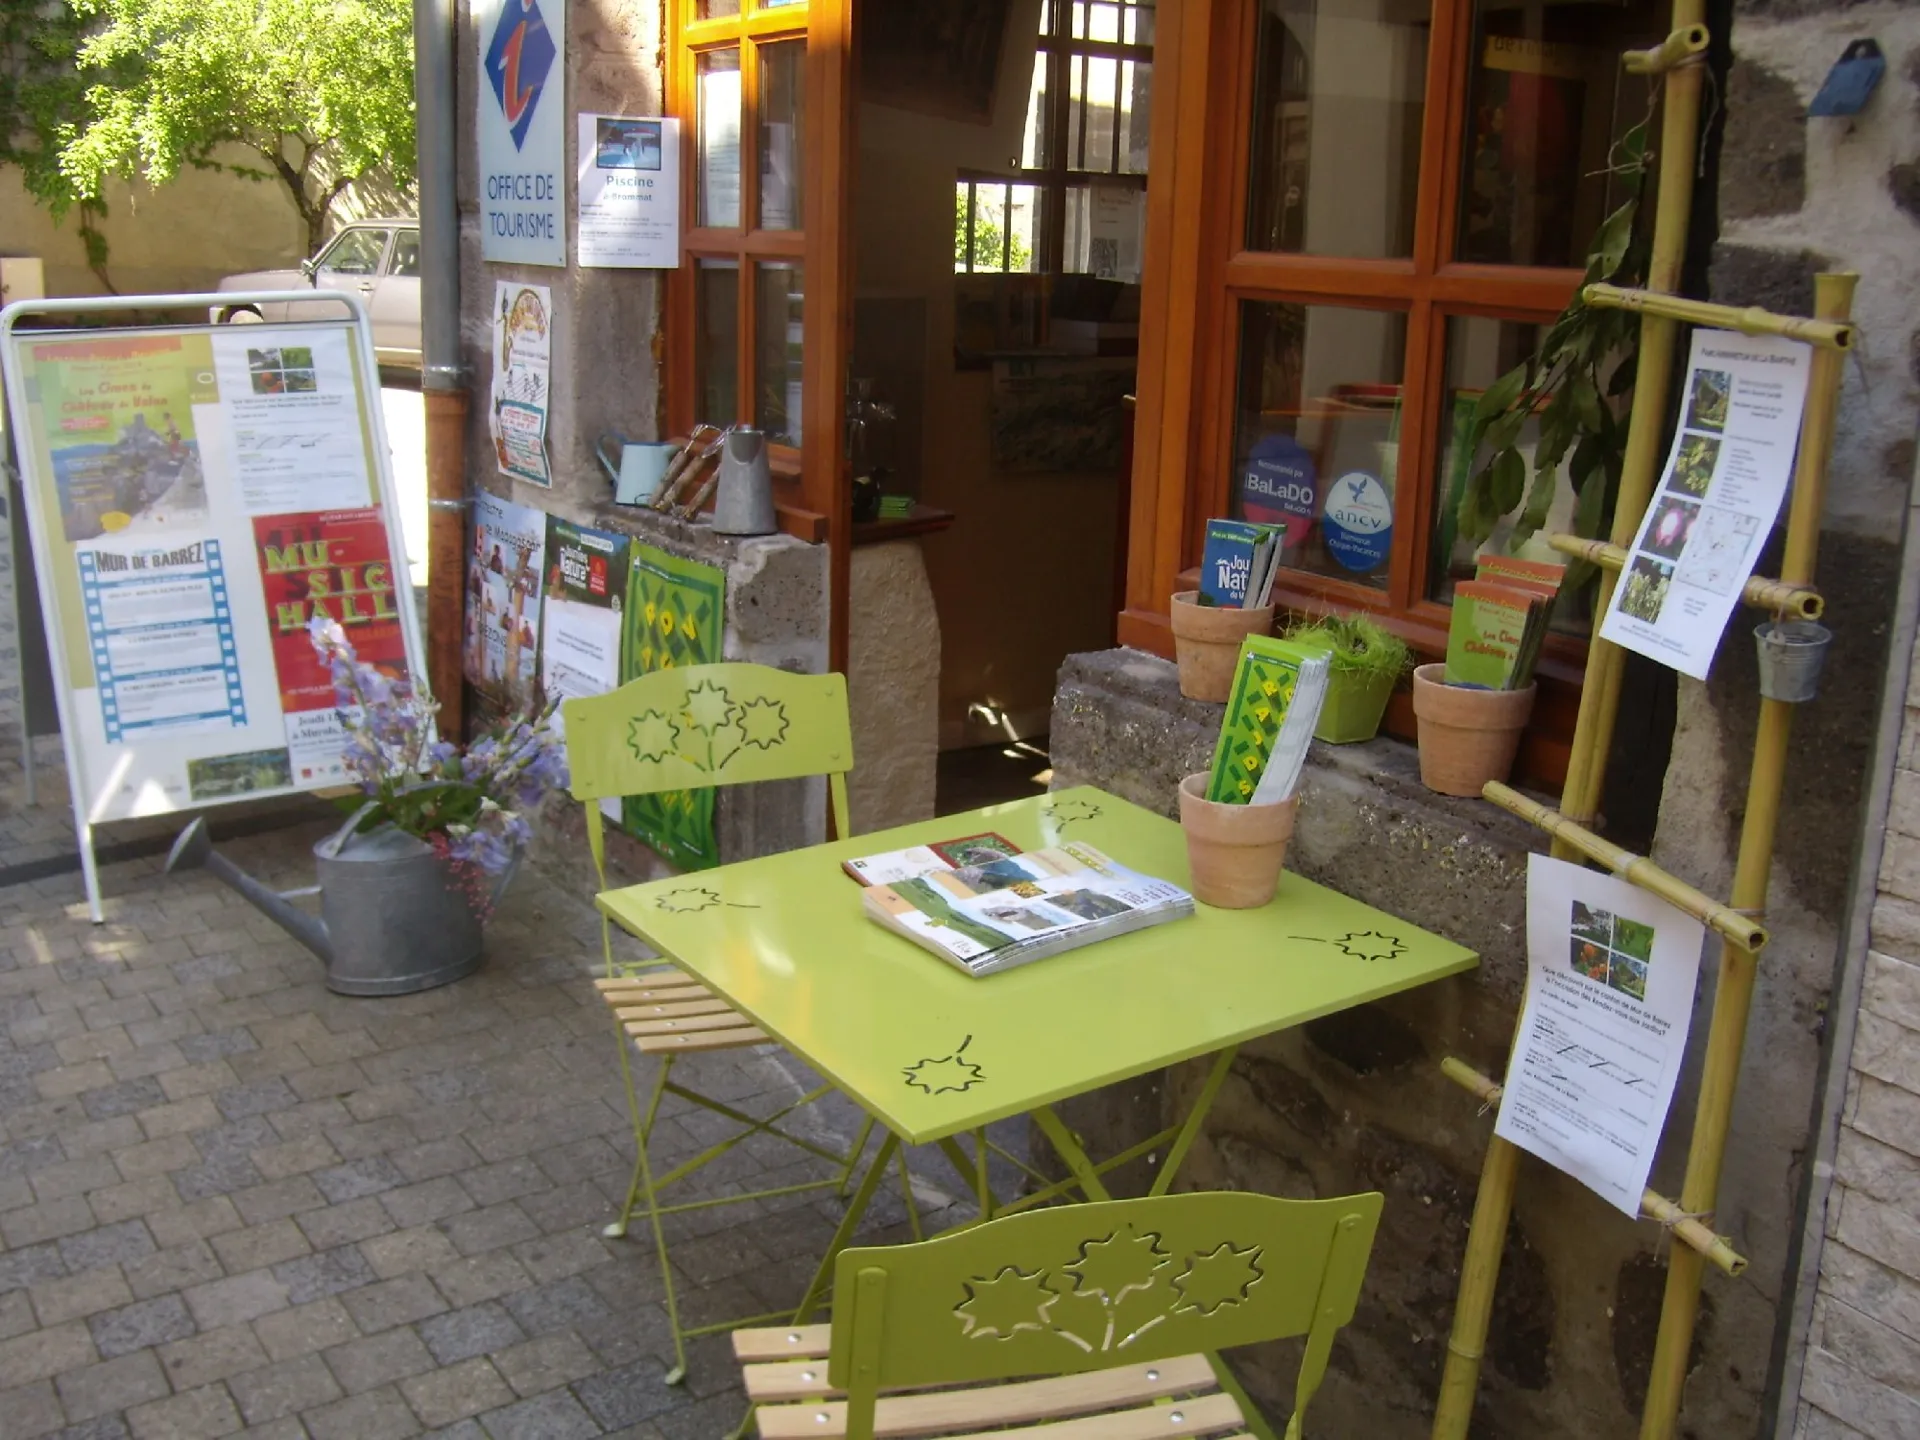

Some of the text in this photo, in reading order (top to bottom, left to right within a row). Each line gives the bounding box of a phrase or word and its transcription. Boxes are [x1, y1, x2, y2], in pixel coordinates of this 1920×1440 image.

[488, 174, 554, 201] OFFICE DE
[606, 175, 654, 188] Piscine
[612, 193, 652, 202] Brommat
[488, 212, 554, 239] TOURISME
[1248, 473, 1314, 505] BaLaDO
[1334, 509, 1382, 529] ancv
[95, 541, 204, 573] MUR DE BARREZ
[264, 540, 328, 574] MU
[1230, 554, 1250, 570] Jou
[307, 564, 388, 598] SIC
[1218, 565, 1247, 590] Nat
[276, 593, 399, 631] HALL
[1600, 990, 1620, 1004] canton
[1630, 1004, 1642, 1014] Mur
